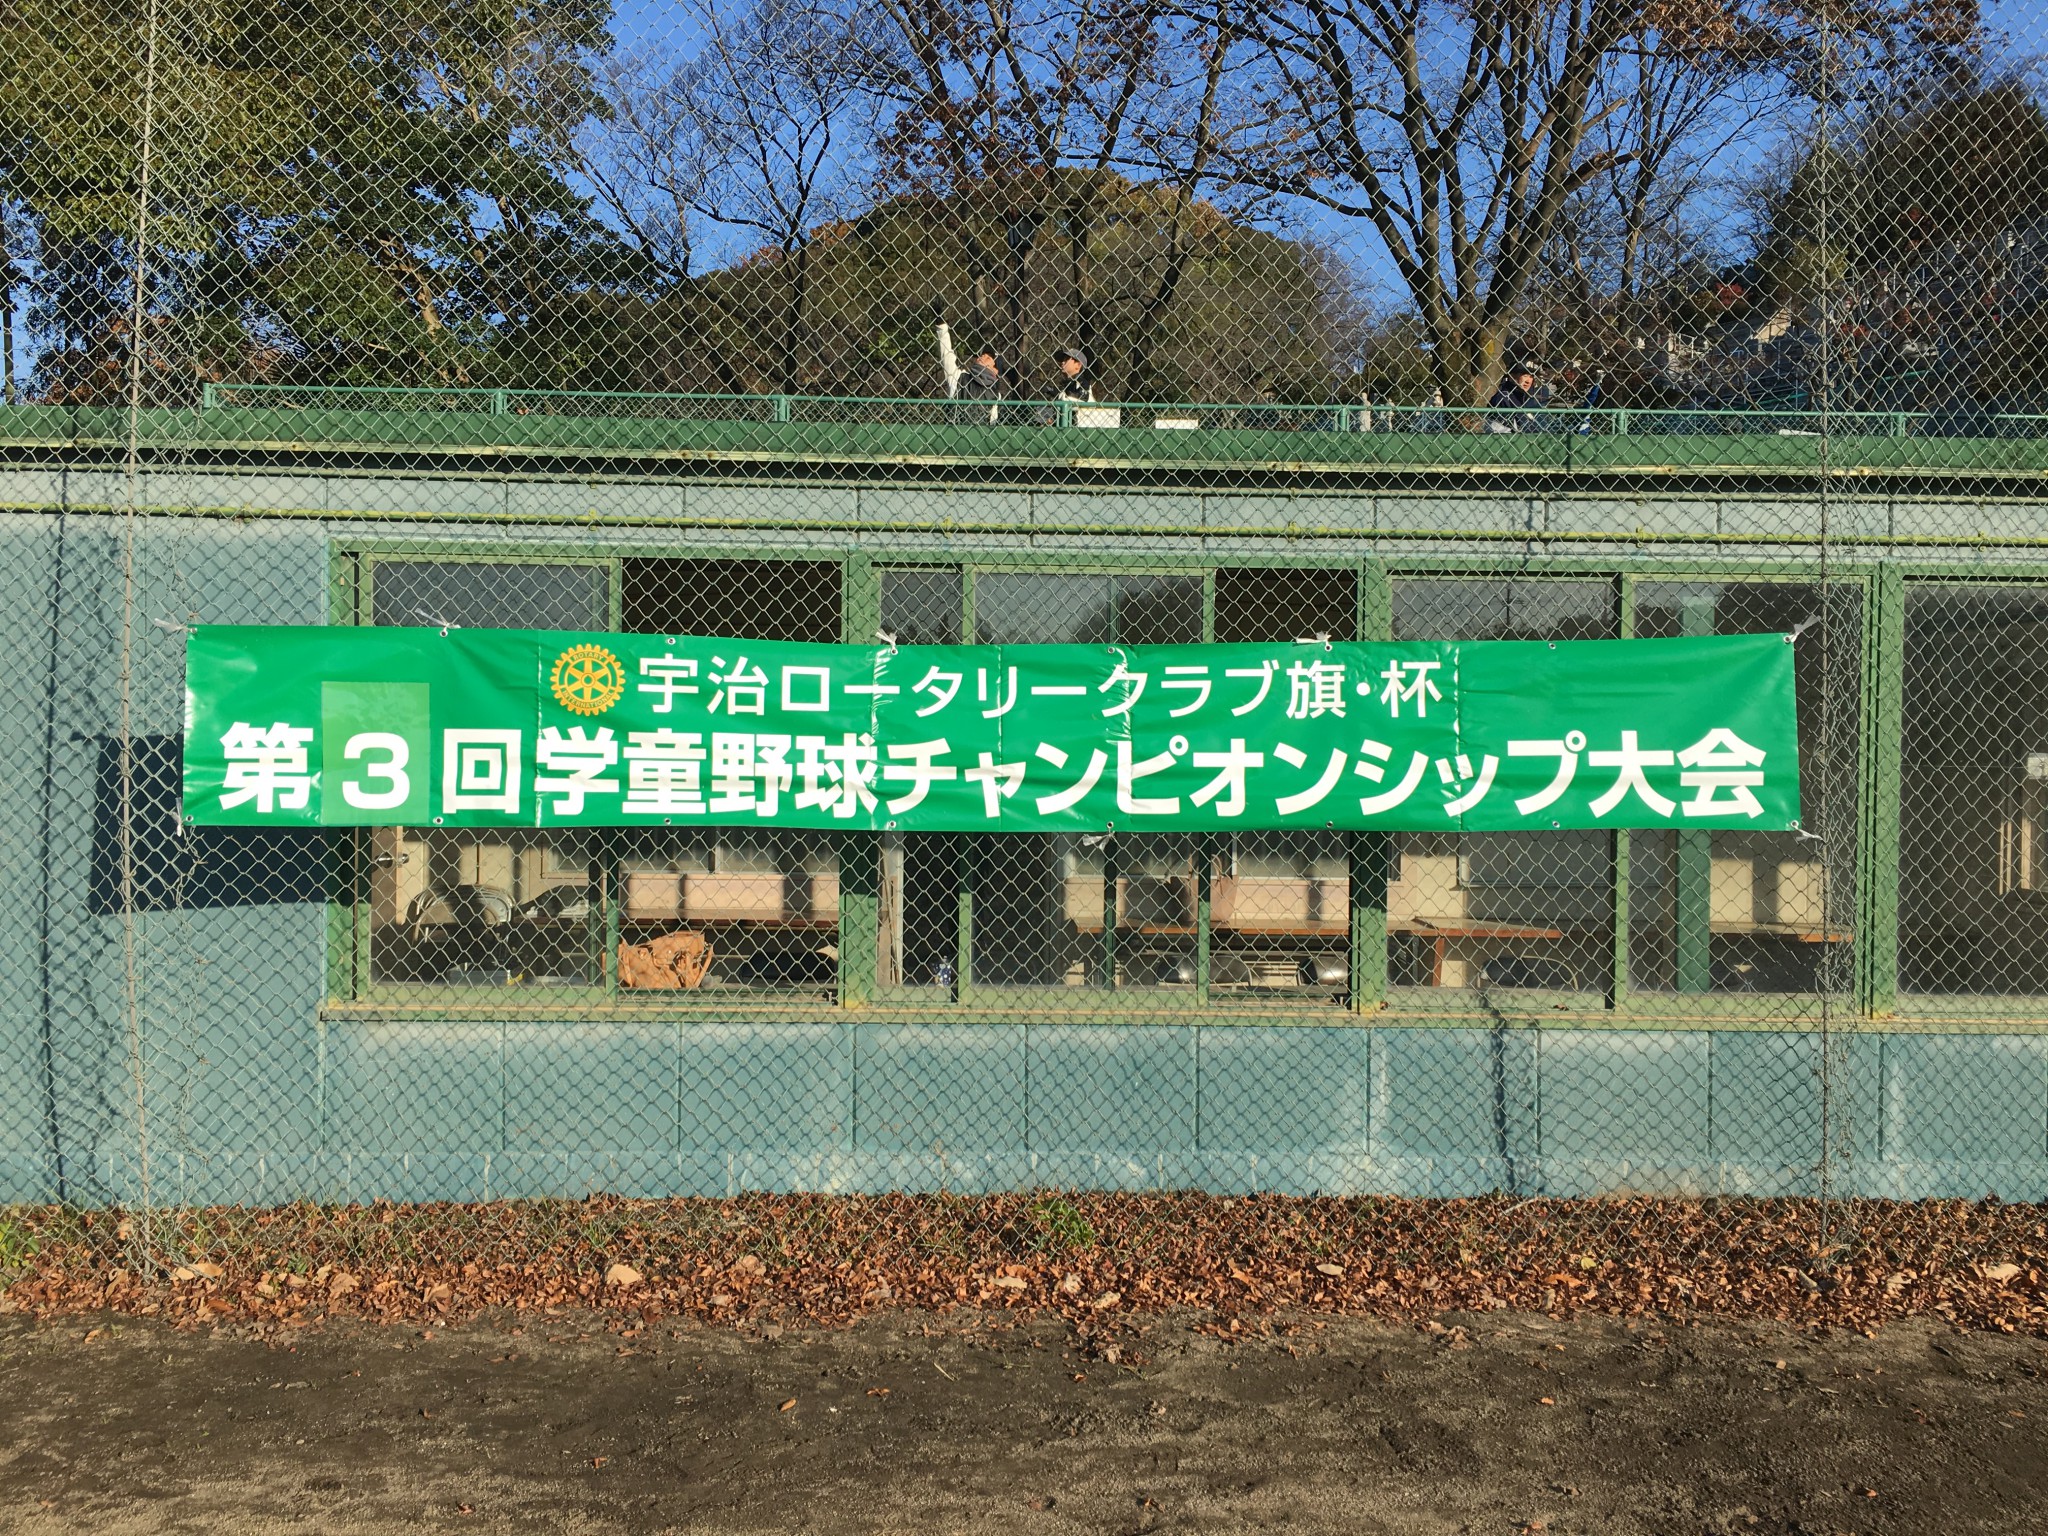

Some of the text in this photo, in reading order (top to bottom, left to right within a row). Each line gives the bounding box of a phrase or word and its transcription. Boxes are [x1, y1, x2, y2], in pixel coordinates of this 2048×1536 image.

[638, 656, 1442, 718] 宇治ロータリークラブ旗・杯
[219, 722, 1766, 818] 第3回学童野球チャンピオンシップ大会
